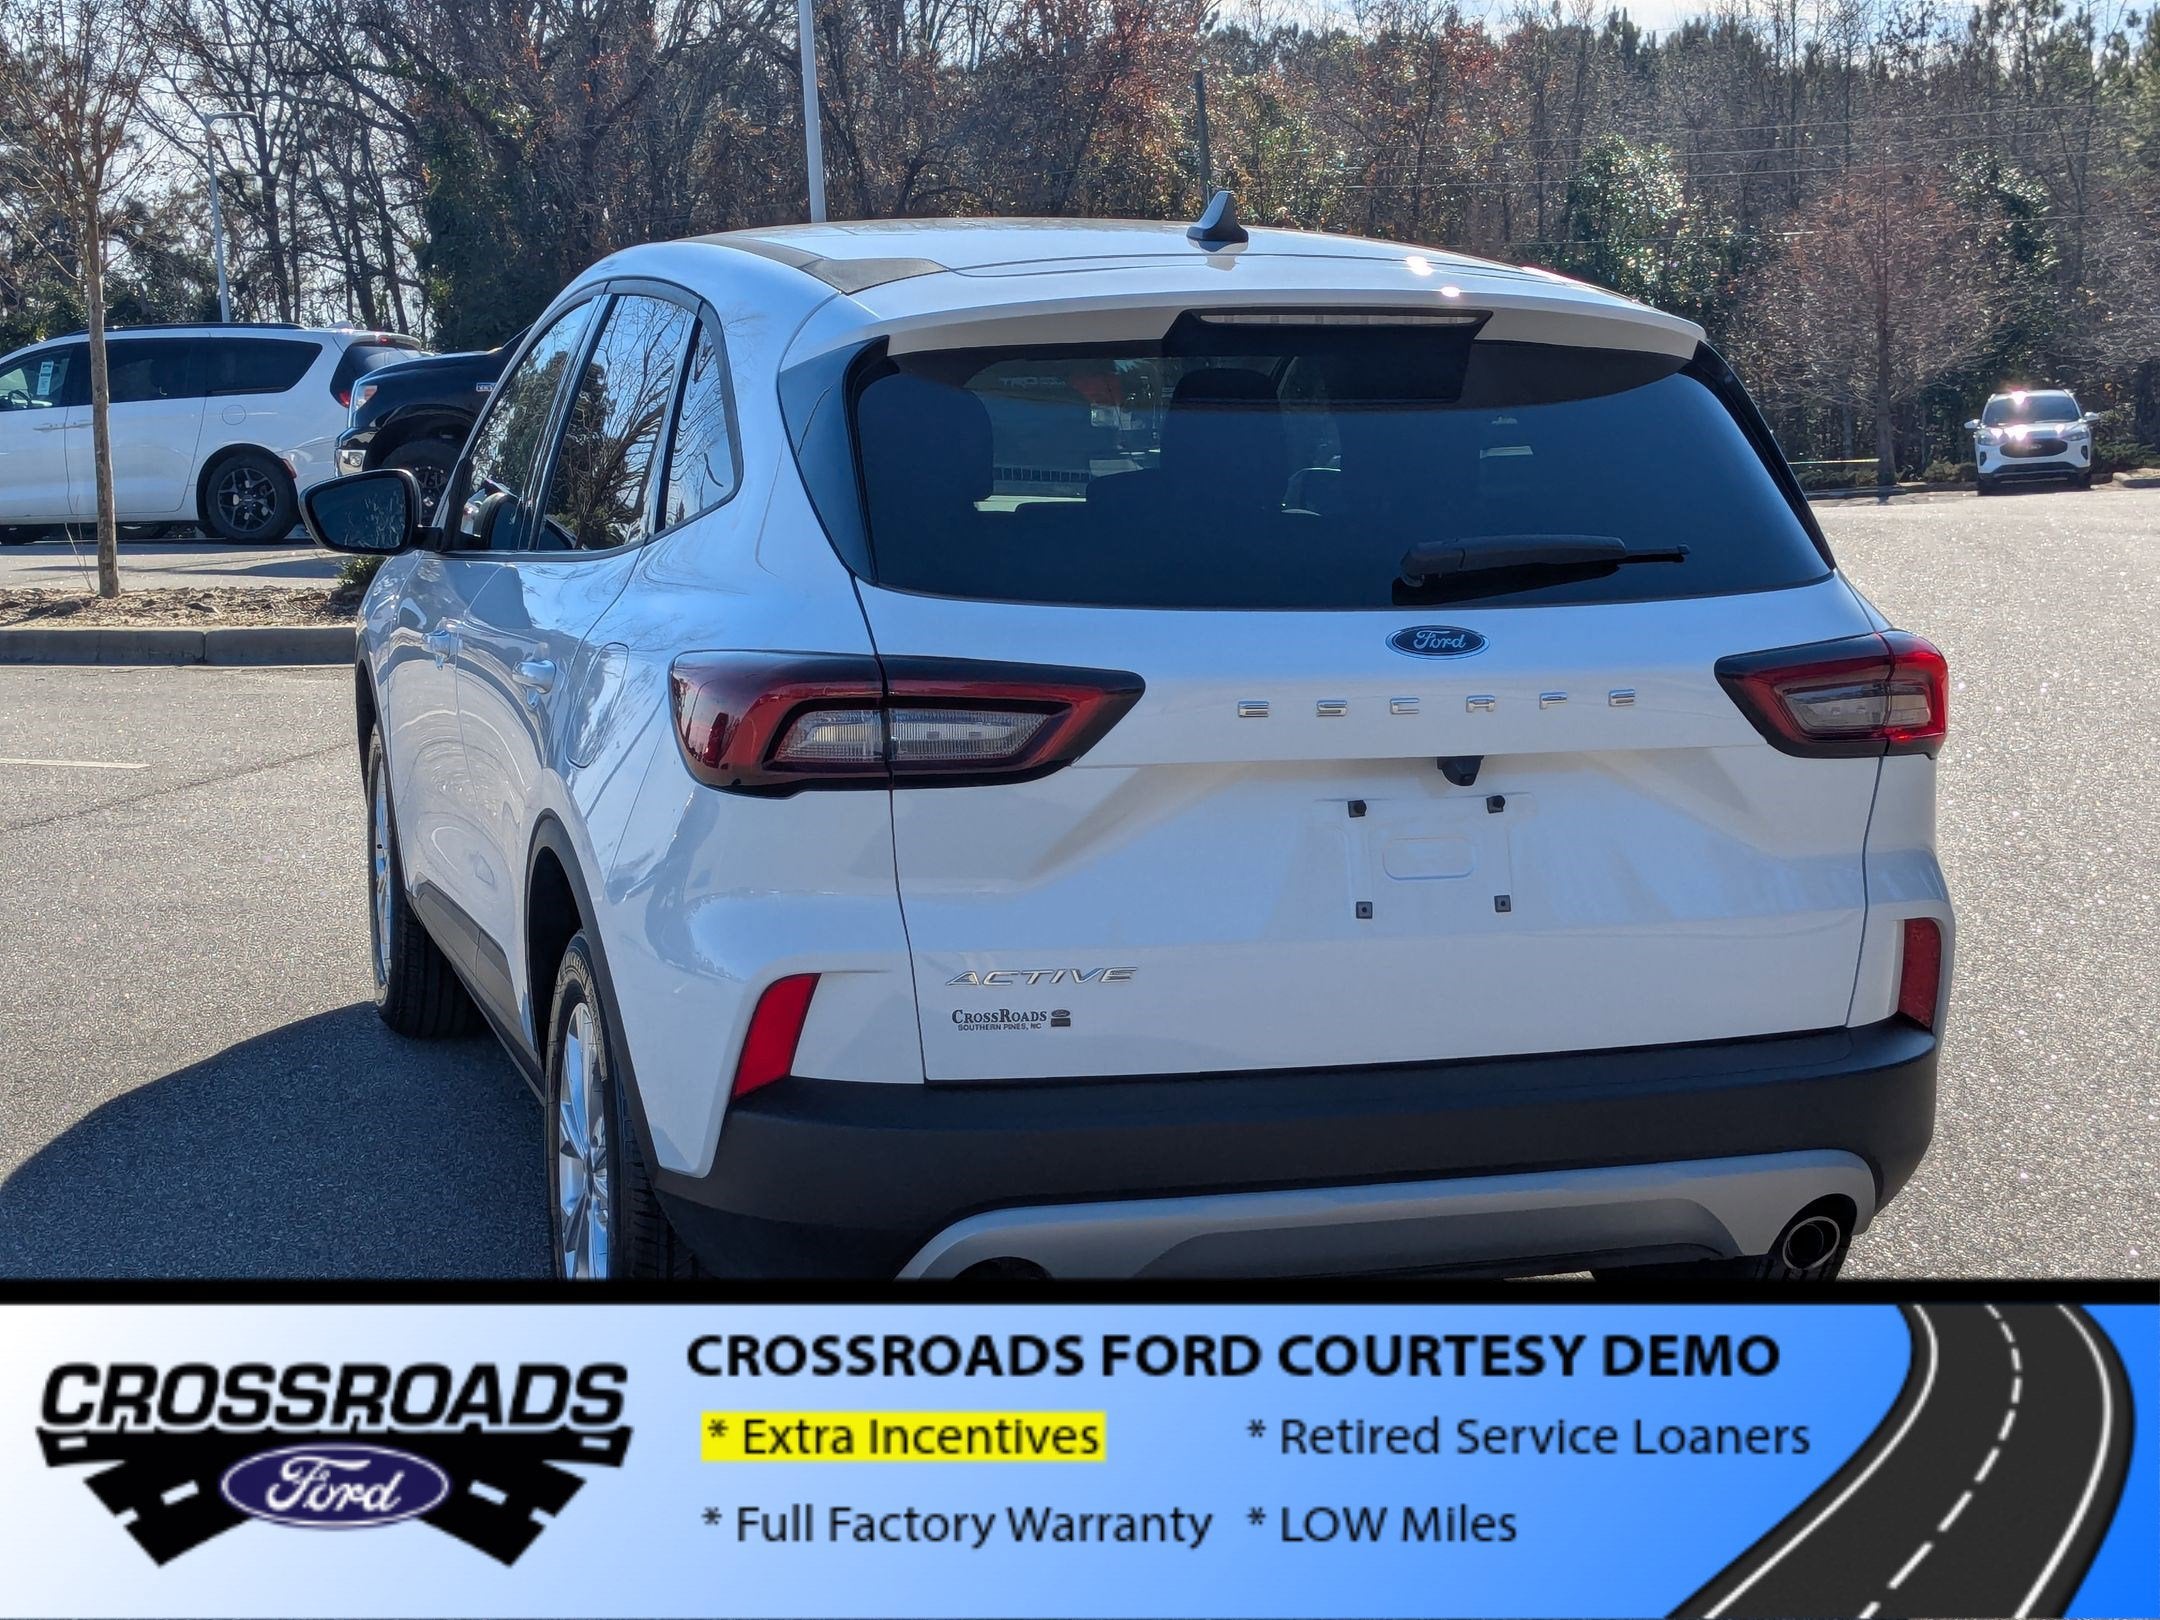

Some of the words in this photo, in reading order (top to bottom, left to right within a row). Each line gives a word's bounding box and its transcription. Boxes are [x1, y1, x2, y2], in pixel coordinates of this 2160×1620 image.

[1412, 629, 1467, 650] Ford
[1237, 688, 1636, 718] ESCAPE
[945, 966, 1138, 987] ACTIVE
[957, 1023, 1001, 1032] SOUTHERN
[1003, 1022, 1029, 1031] PINES,
[1030, 1022, 1042, 1030] NC
